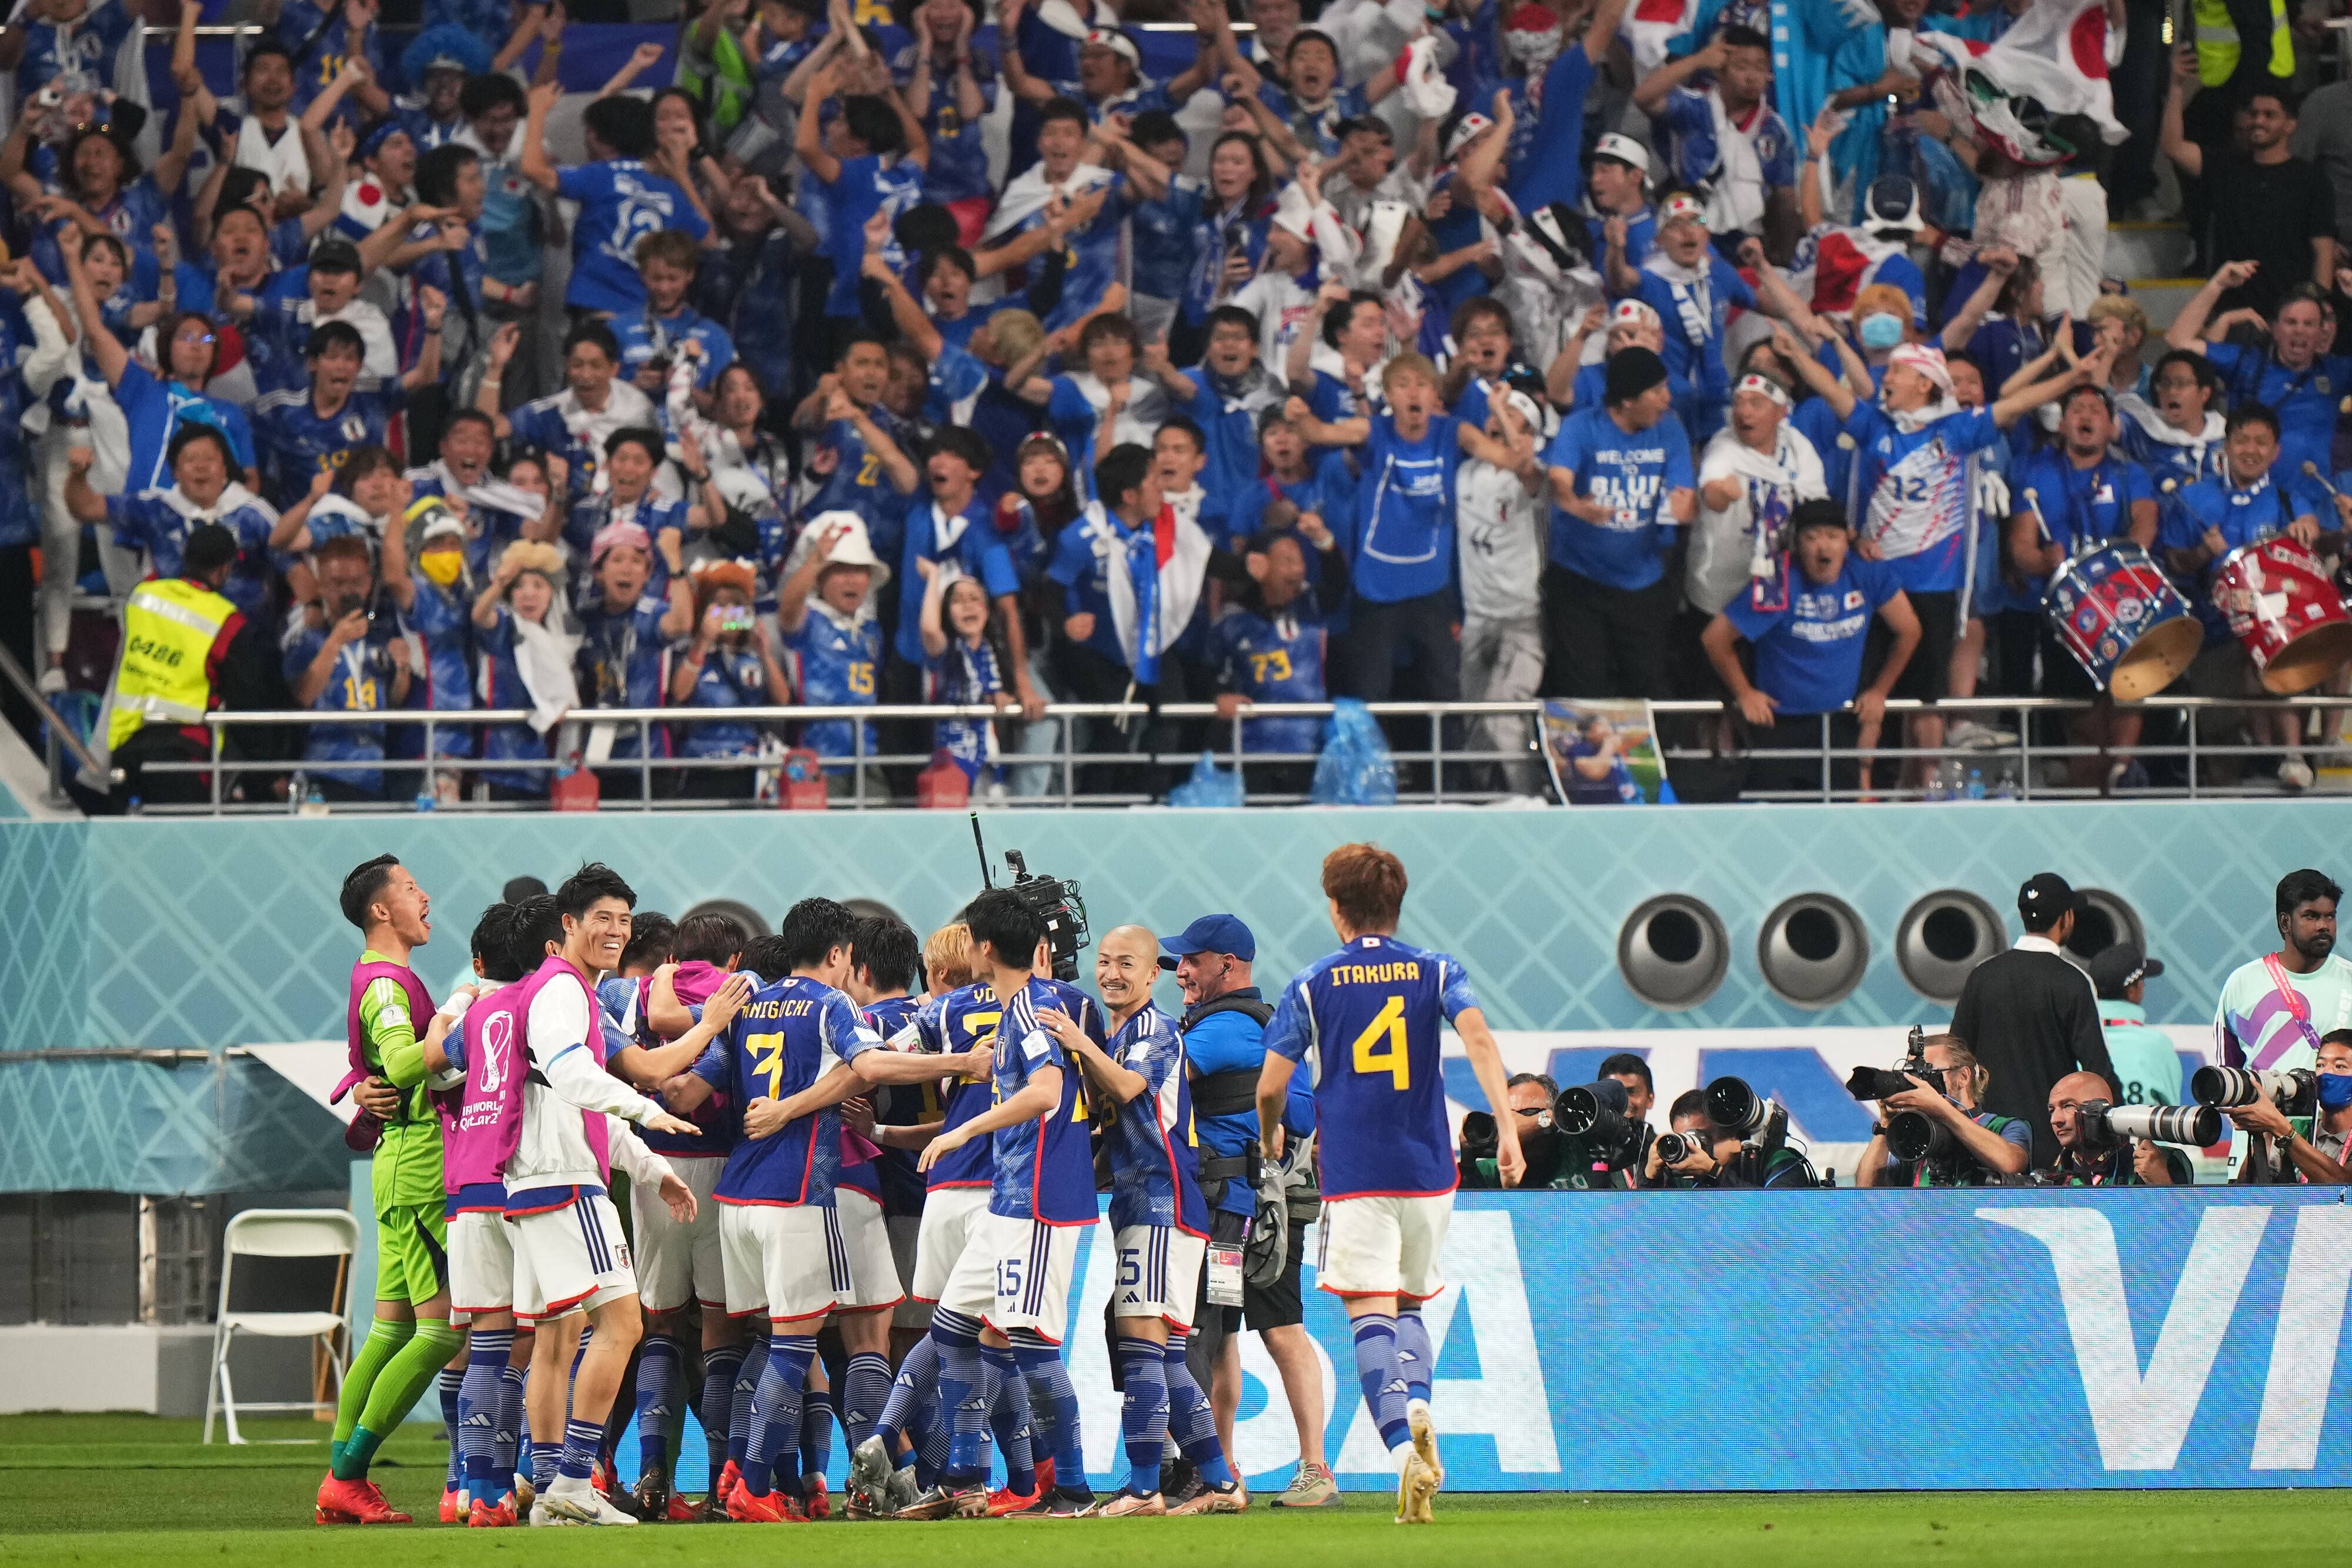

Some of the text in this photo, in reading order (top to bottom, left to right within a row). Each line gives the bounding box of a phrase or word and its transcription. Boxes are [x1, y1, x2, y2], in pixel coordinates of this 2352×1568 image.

[1893, 474, 1927, 502] 12
[848, 661, 875, 696] 15
[1250, 648, 1293, 683] 73
[1330, 961, 1420, 987] ITAKURA
[1352, 995, 1410, 1091] 4
[997, 1259, 1022, 1296] 15
